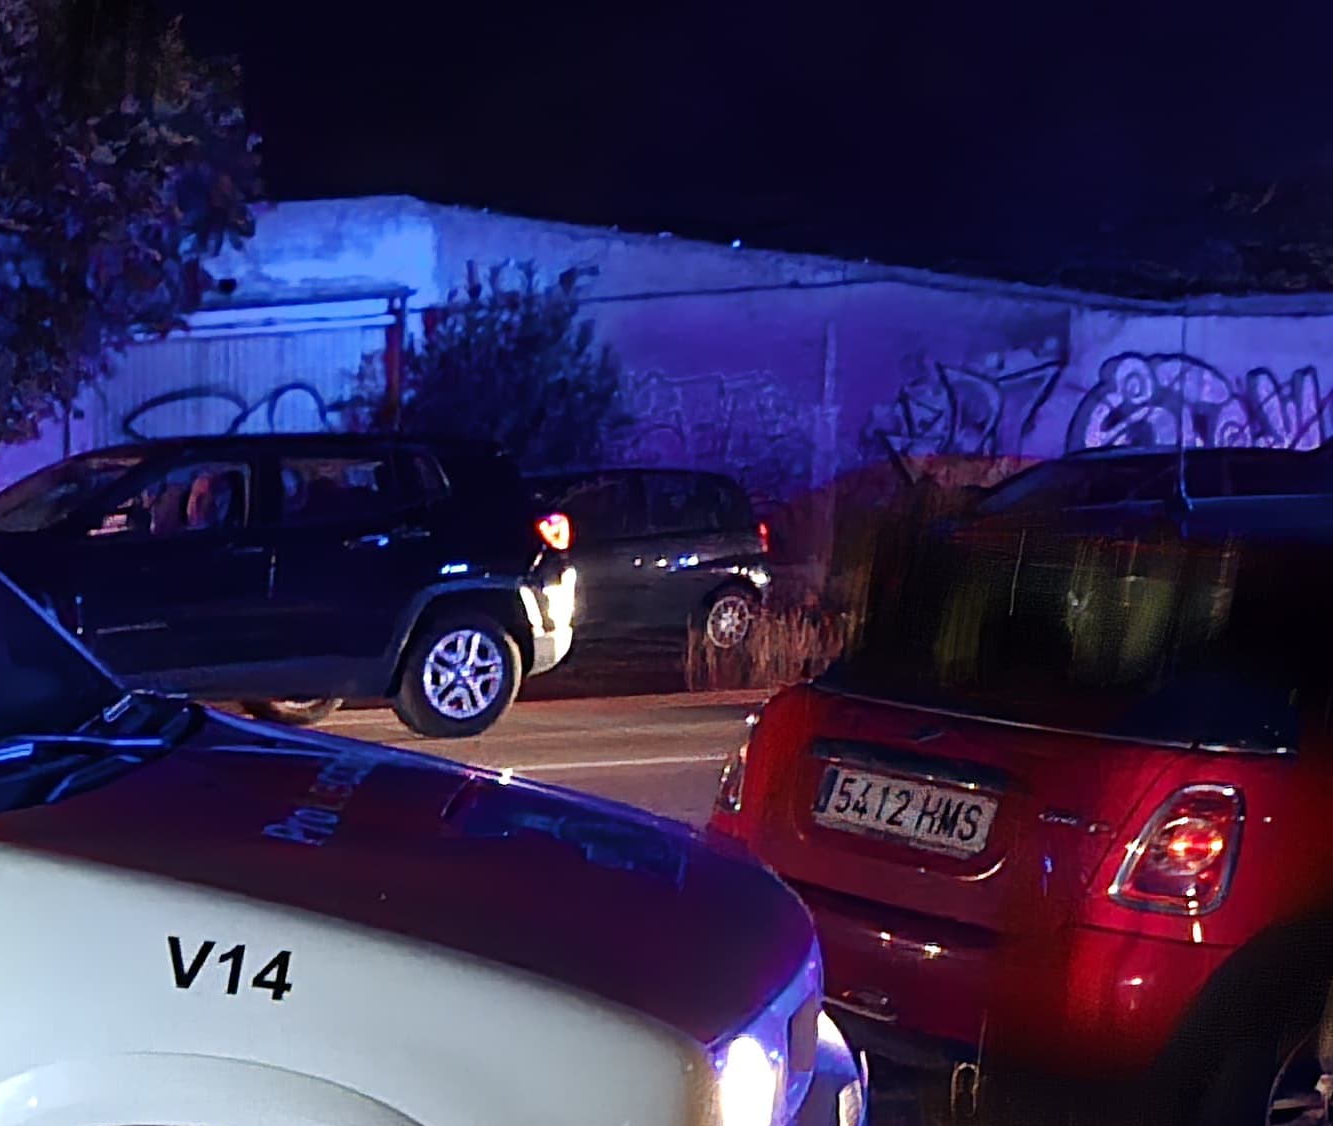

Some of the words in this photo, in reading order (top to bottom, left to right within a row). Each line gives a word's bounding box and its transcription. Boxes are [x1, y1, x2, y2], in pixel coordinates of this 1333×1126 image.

[835, 777, 911, 827] 5412
[915, 793, 982, 842] HMS
[168, 936, 292, 1001] V14
